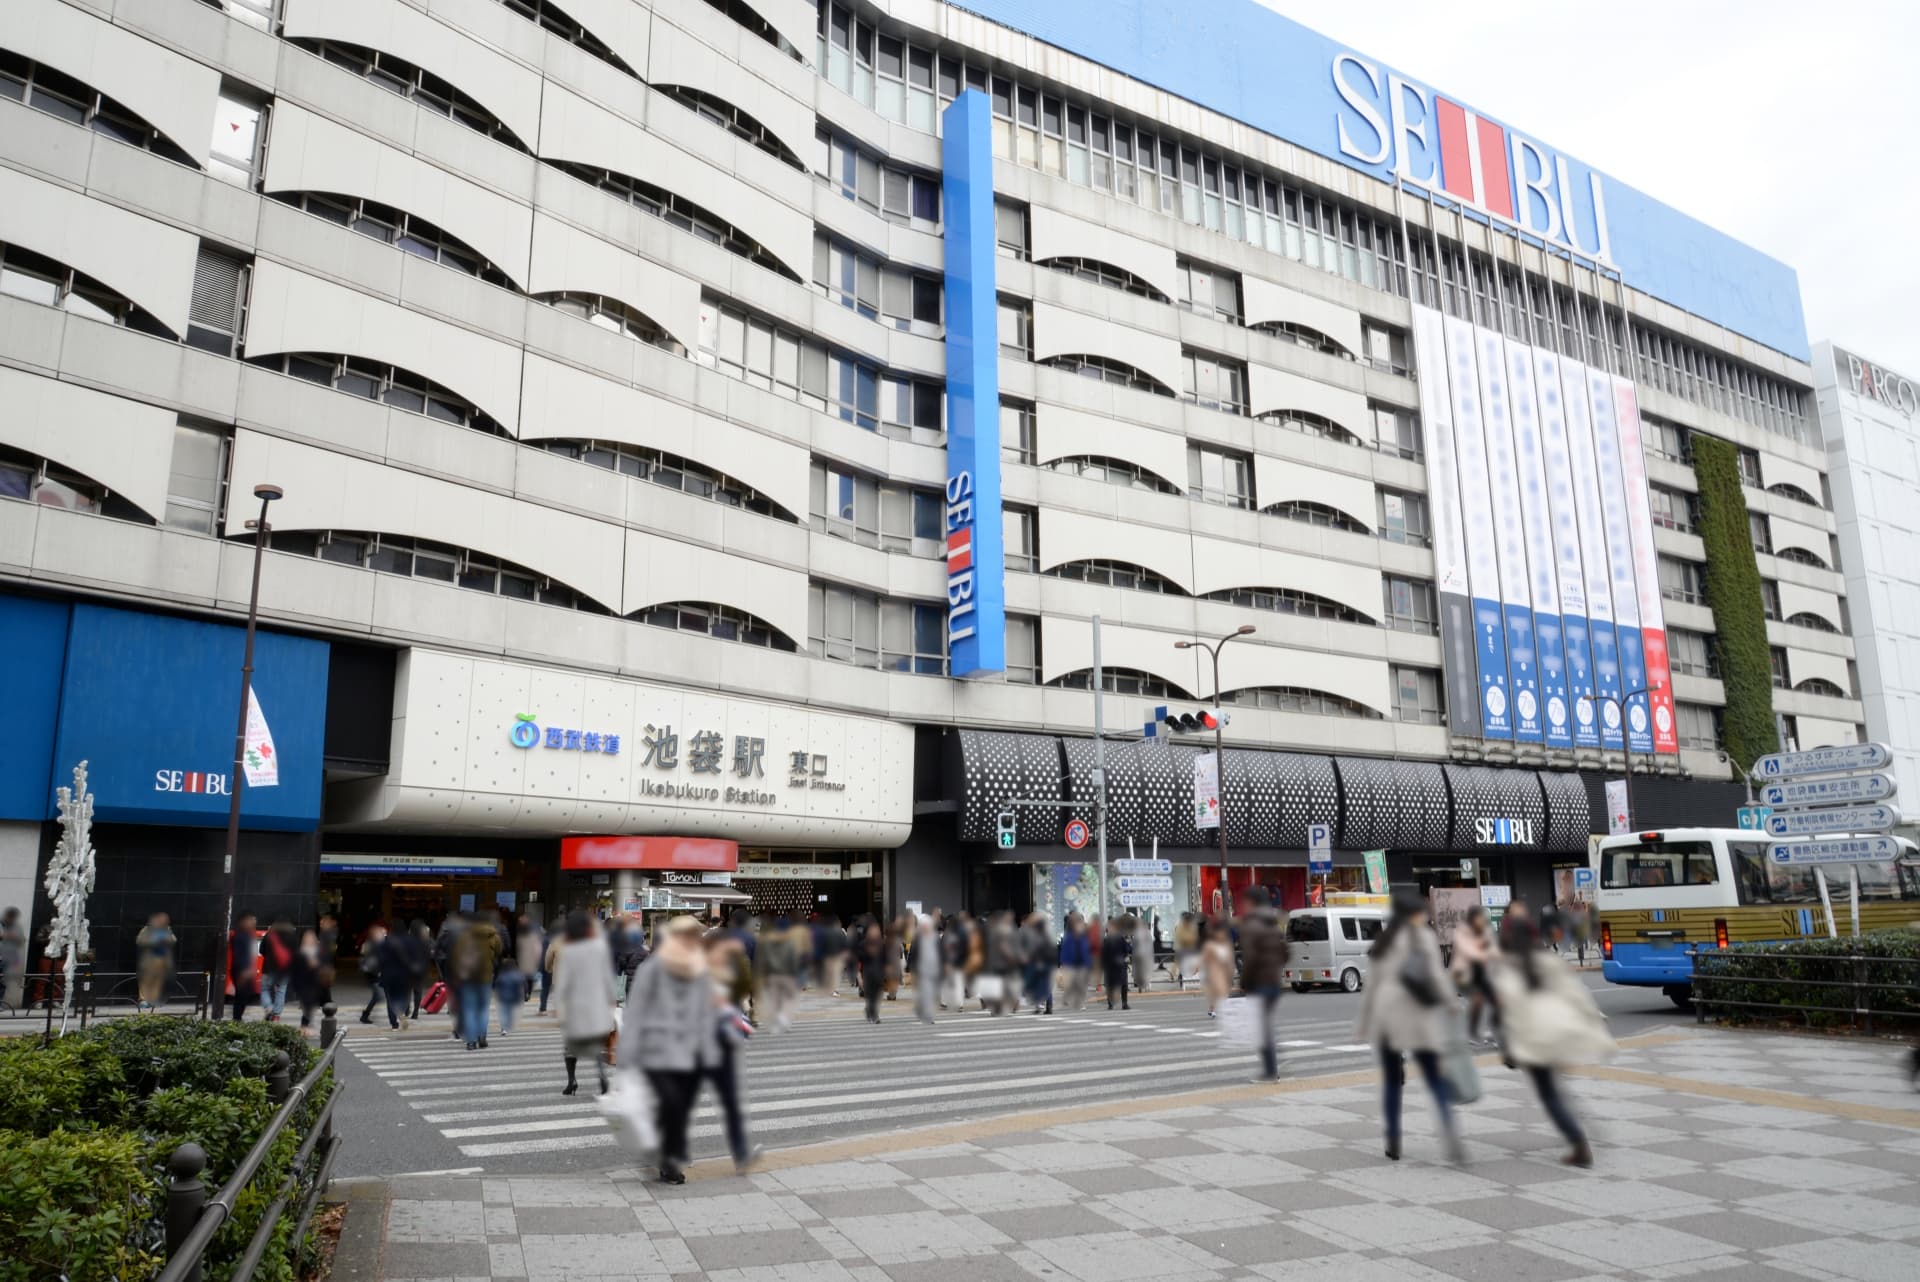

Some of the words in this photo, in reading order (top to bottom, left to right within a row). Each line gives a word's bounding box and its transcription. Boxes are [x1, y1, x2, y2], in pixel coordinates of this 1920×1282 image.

[1332, 54, 1614, 266] SEIBU
[1848, 354, 1917, 418] PARCO
[946, 471, 975, 646] SEIBU
[545, 727, 620, 755] 西武鉄道
[642, 723, 766, 778] 池袋駅
[790, 750, 828, 777] 東口
[640, 778, 720, 801] Ikebukuro
[725, 786, 777, 806] Station
[1312, 828, 1325, 846] P
[1475, 817, 1534, 844] SEIBU
[1575, 870, 1592, 887] P
[1639, 909, 1680, 923] SEIBU
